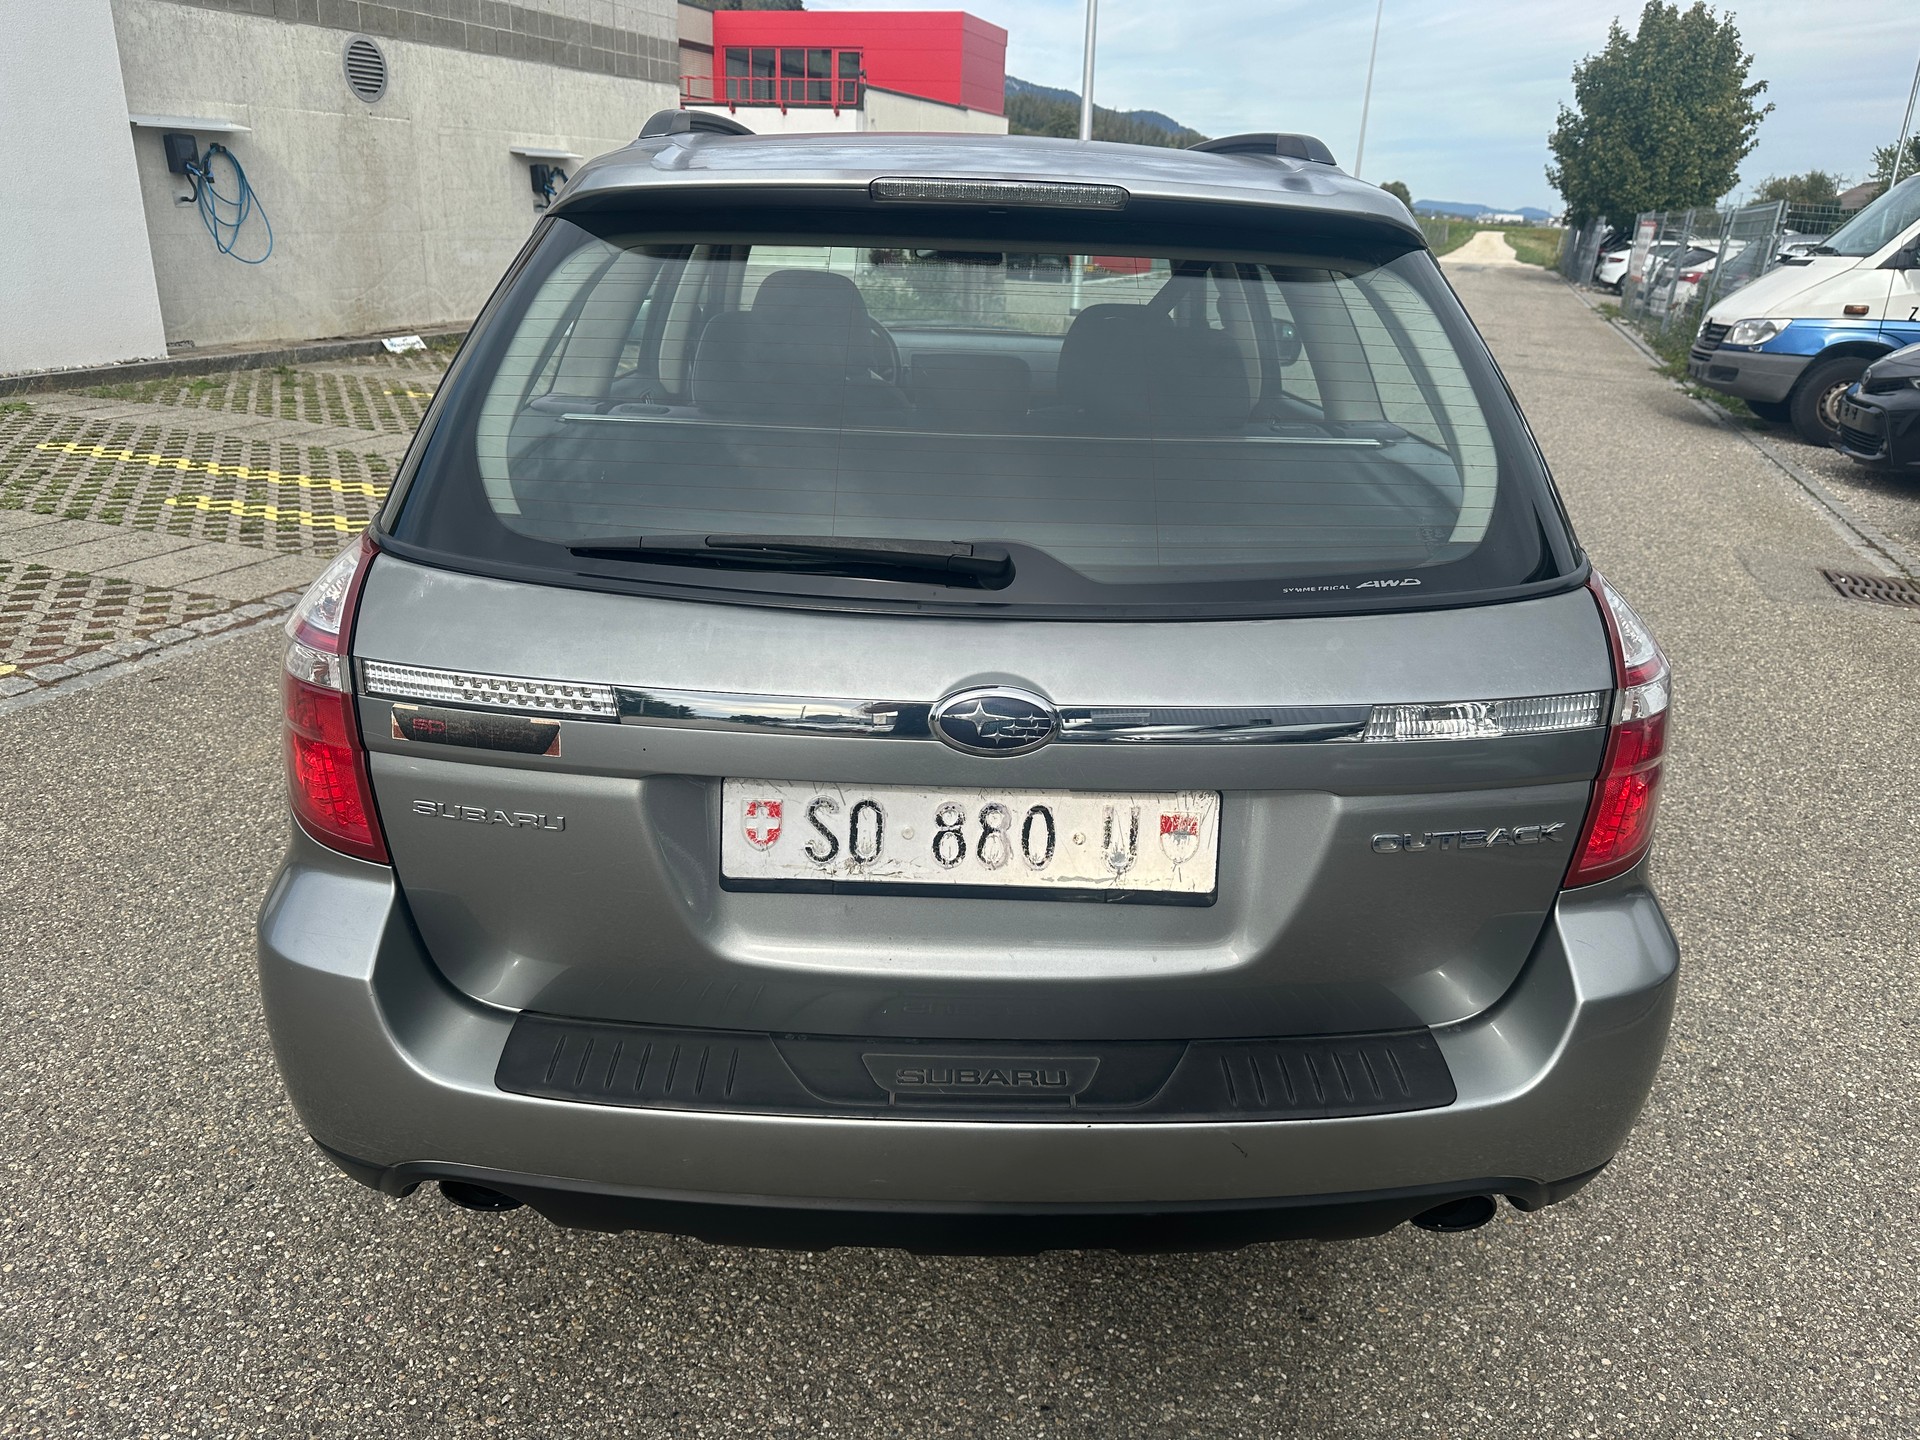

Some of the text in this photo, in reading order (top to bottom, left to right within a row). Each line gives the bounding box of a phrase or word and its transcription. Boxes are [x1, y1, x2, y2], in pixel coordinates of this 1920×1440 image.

[1282, 578, 1422, 594] SYMMETRICAL AWD
[412, 799, 565, 832] SUBARU
[804, 795, 1141, 873] SO 880 U
[1371, 822, 1566, 854] OUTBACK
[896, 1068, 1068, 1088] SUBARU
